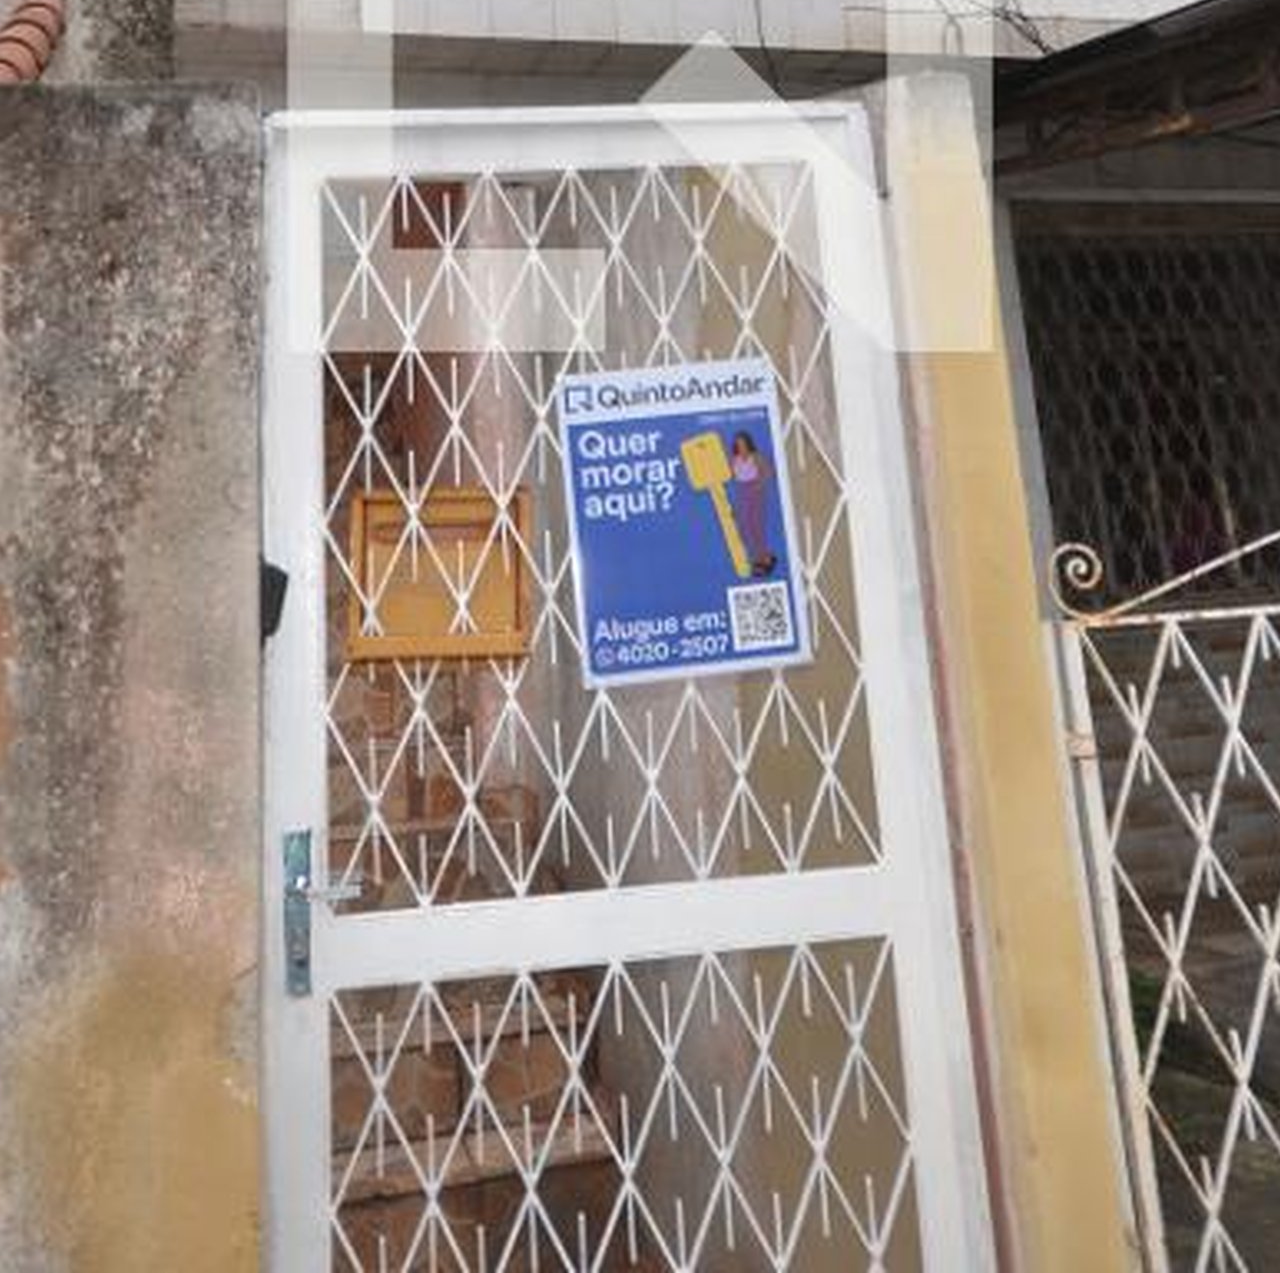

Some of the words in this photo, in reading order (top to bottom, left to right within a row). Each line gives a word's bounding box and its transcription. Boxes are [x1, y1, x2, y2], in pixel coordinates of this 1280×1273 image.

[597, 376, 764, 409] QuintoAndar
[578, 430, 661, 459] Quer
[581, 460, 681, 488] morar
[584, 484, 675, 521] aqui?
[594, 616, 679, 643] Alugue
[683, 611, 728, 632] em:
